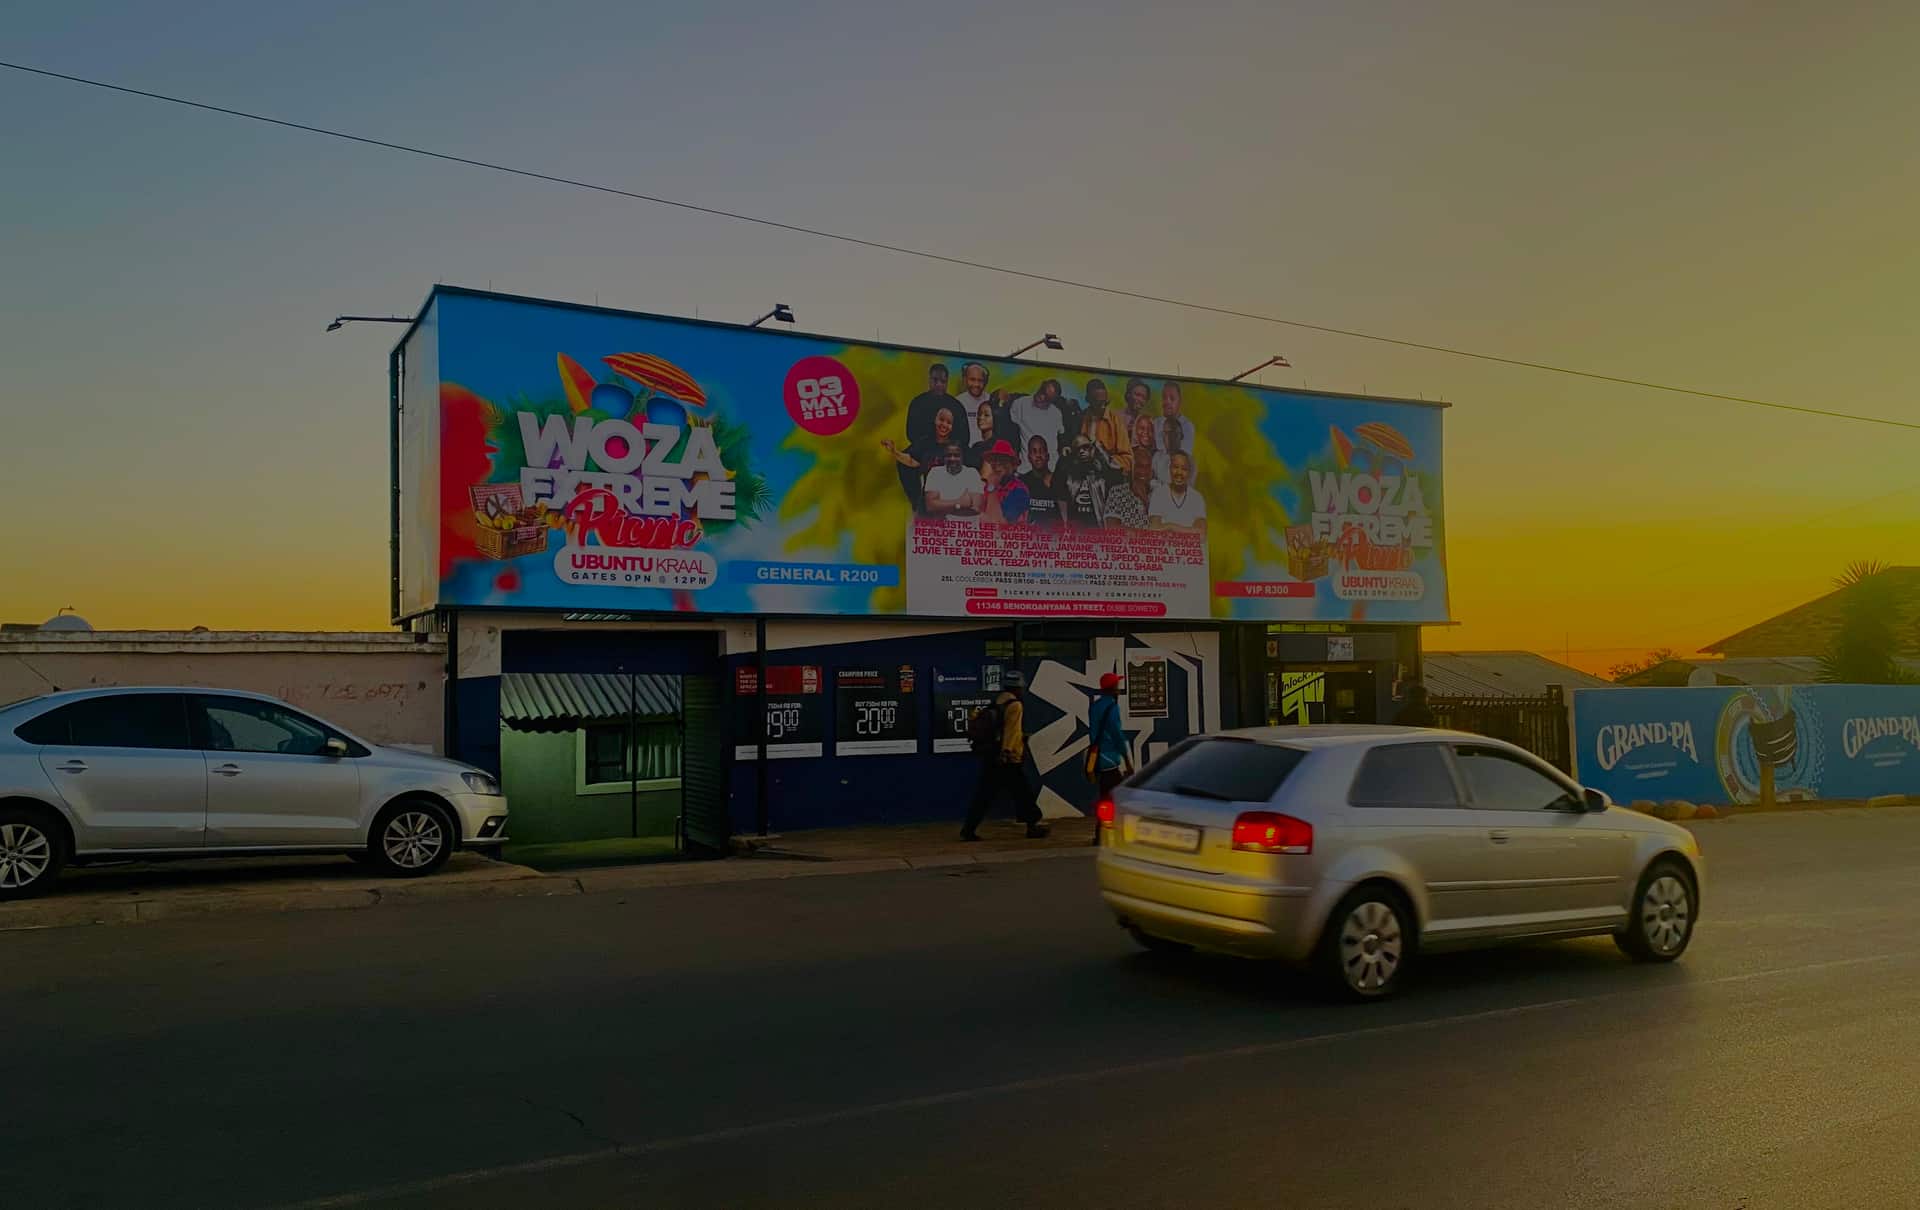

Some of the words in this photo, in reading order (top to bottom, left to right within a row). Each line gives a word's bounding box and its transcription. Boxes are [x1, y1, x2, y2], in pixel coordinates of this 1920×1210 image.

[797, 375, 843, 400] 03
[800, 394, 846, 412] MAY
[803, 407, 848, 421] 2025
[517, 411, 726, 483] WOZA
[520, 467, 737, 520] EXTREME
[1308, 470, 1425, 518] WOZA
[565, 488, 703, 549] Picnic
[912, 536, 920, 545] T
[921, 537, 949, 547] BOSE
[1004, 541, 1019, 550] MO
[1021, 542, 1049, 551] FLAVA
[1001, 532, 1032, 541] QUEEN
[1036, 534, 1051, 542] TEE
[912, 545, 942, 555] JOVIE
[943, 547, 962, 556] TEE
[964, 547, 972, 557] &
[974, 549, 1013, 558] MTEEZO
[1020, 550, 1060, 560] MPOWER
[572, 553, 652, 574] UBUNTU
[655, 557, 709, 575] KRAAL
[961, 557, 993, 567] BLVCK
[1032, 559, 1048, 568] 911
[1054, 559, 1099, 570] PRECIOUS
[572, 571, 617, 584] GATES
[624, 573, 651, 587] OPN
[674, 576, 708, 589] 12PM
[757, 567, 833, 582] GENERAL
[840, 569, 879, 583] R200
[1342, 575, 1387, 588] UBUNTU
[1246, 585, 1262, 595] VIP
